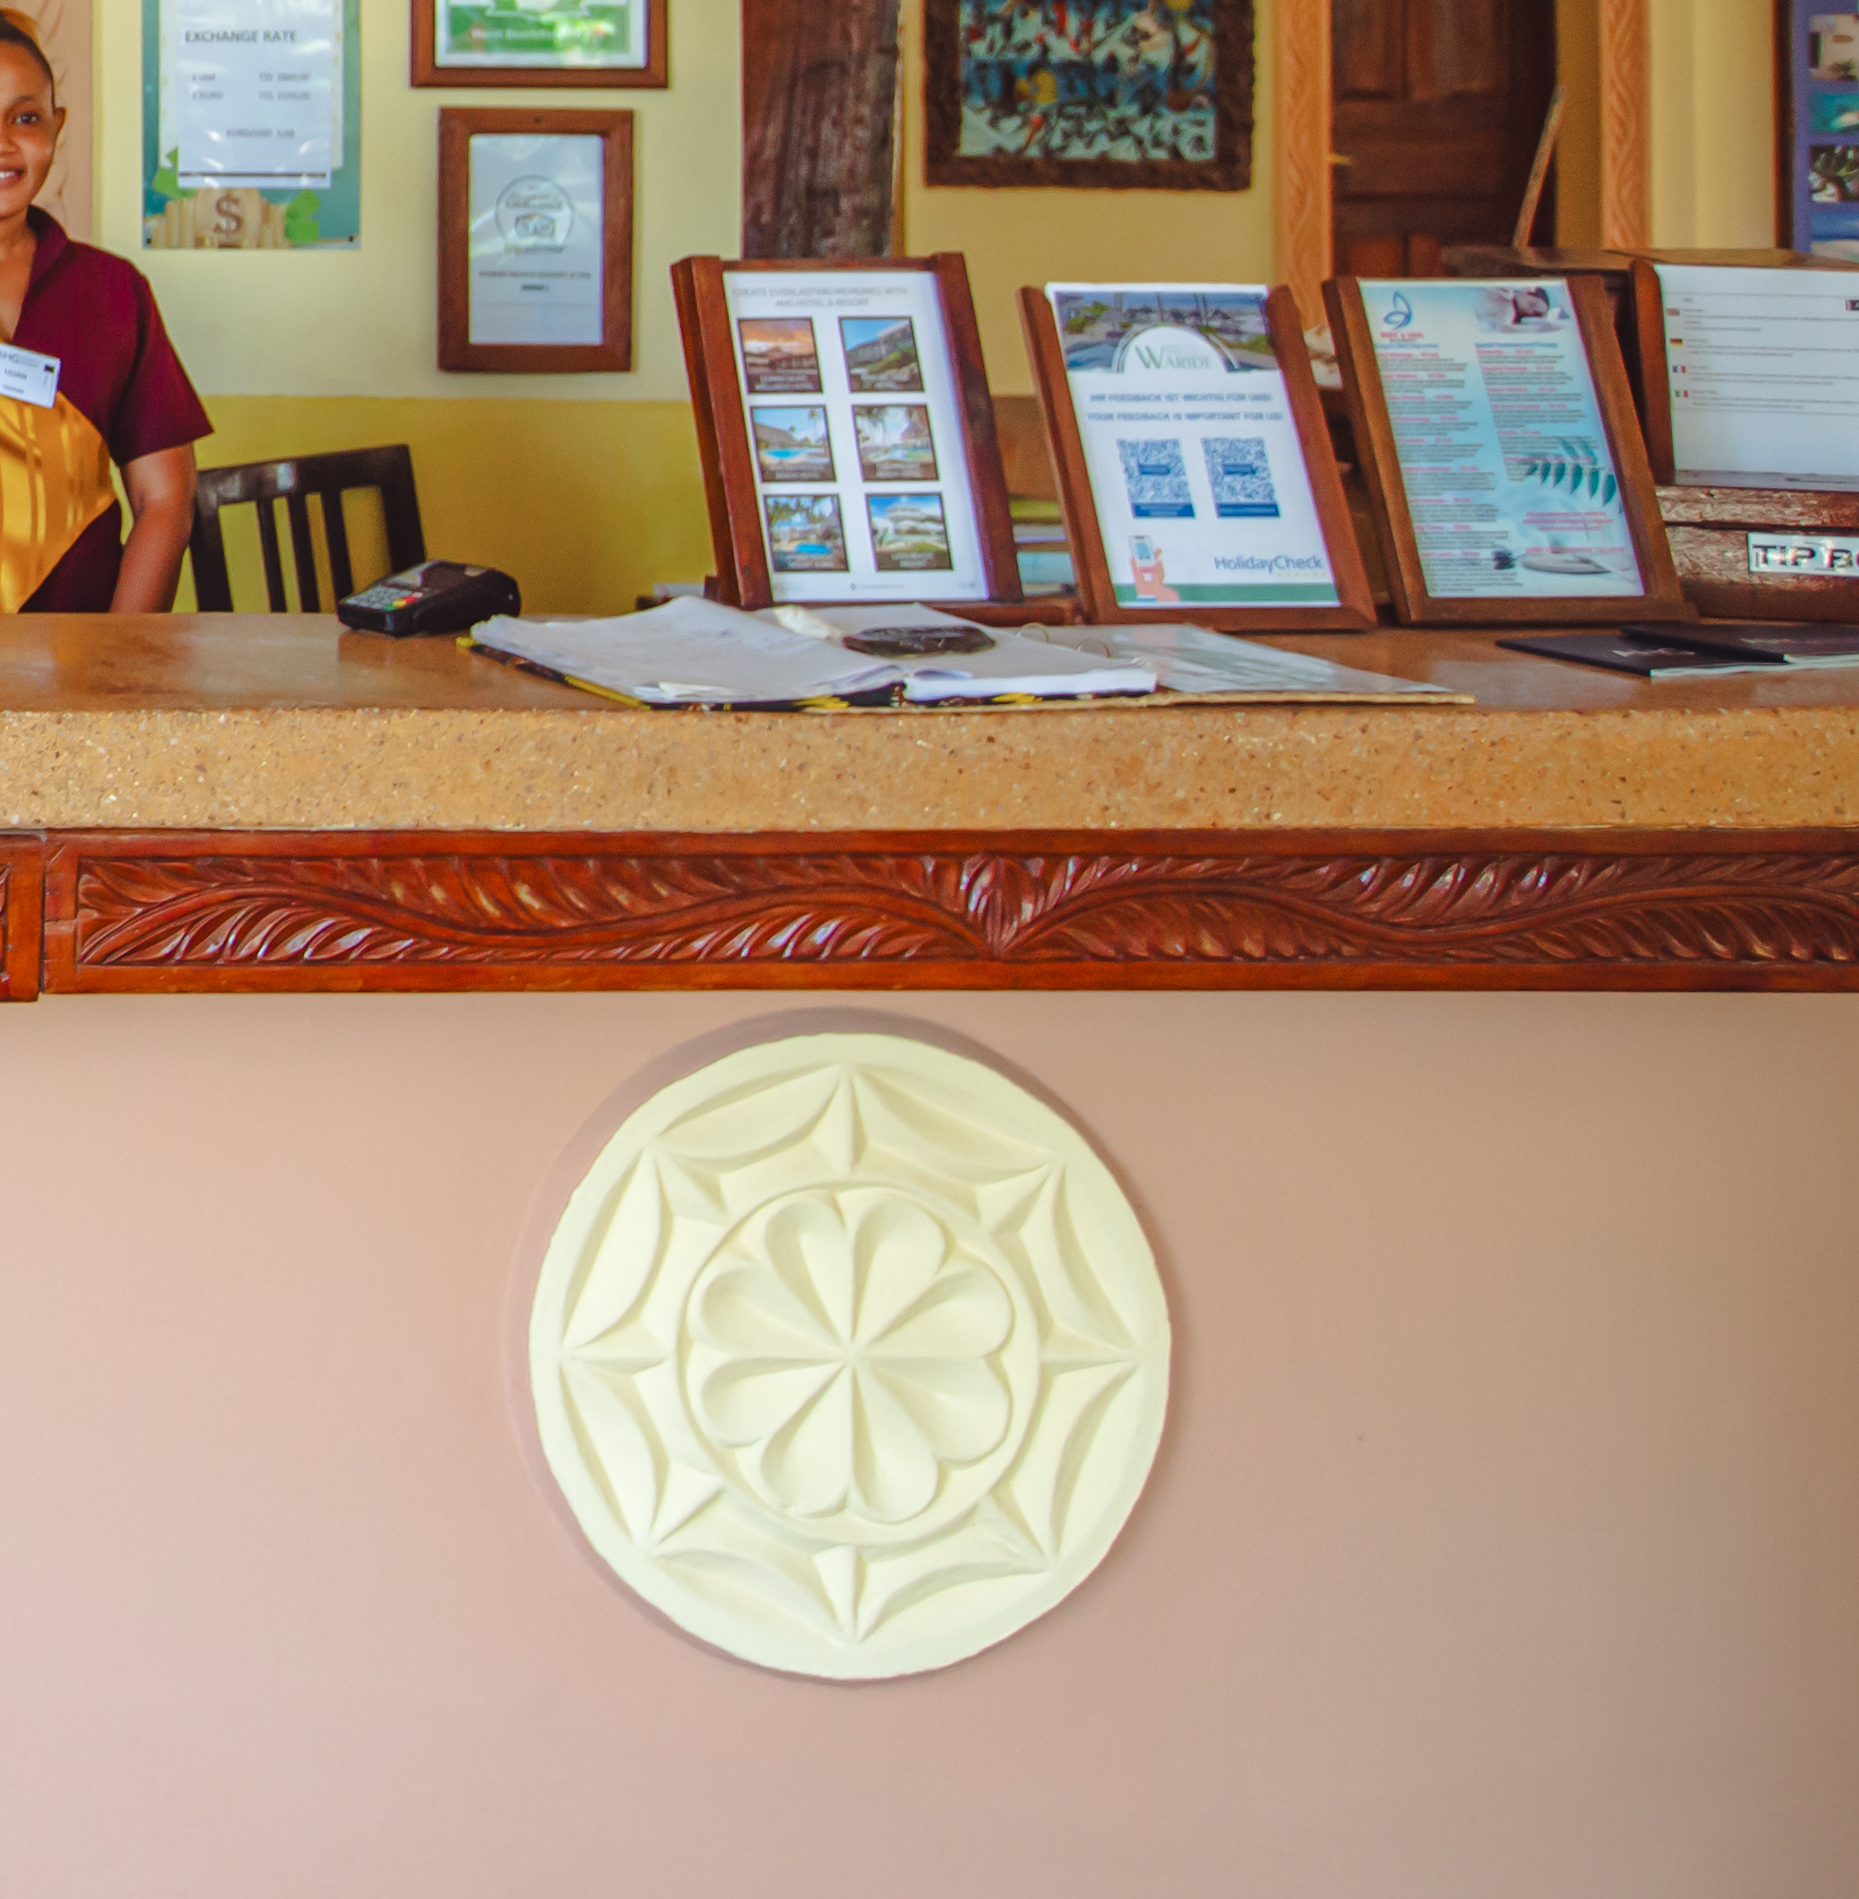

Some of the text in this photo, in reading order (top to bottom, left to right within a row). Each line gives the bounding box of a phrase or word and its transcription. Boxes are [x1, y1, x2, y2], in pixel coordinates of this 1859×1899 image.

[185, 30, 297, 43] EXCHANGE RATE
[1135, 344, 1210, 369] WARIDI
[1116, 411, 1170, 421] FEEDBACK
[1214, 554, 1323, 574] HolidayCheck
[1752, 545, 1859, 569] TIP B
